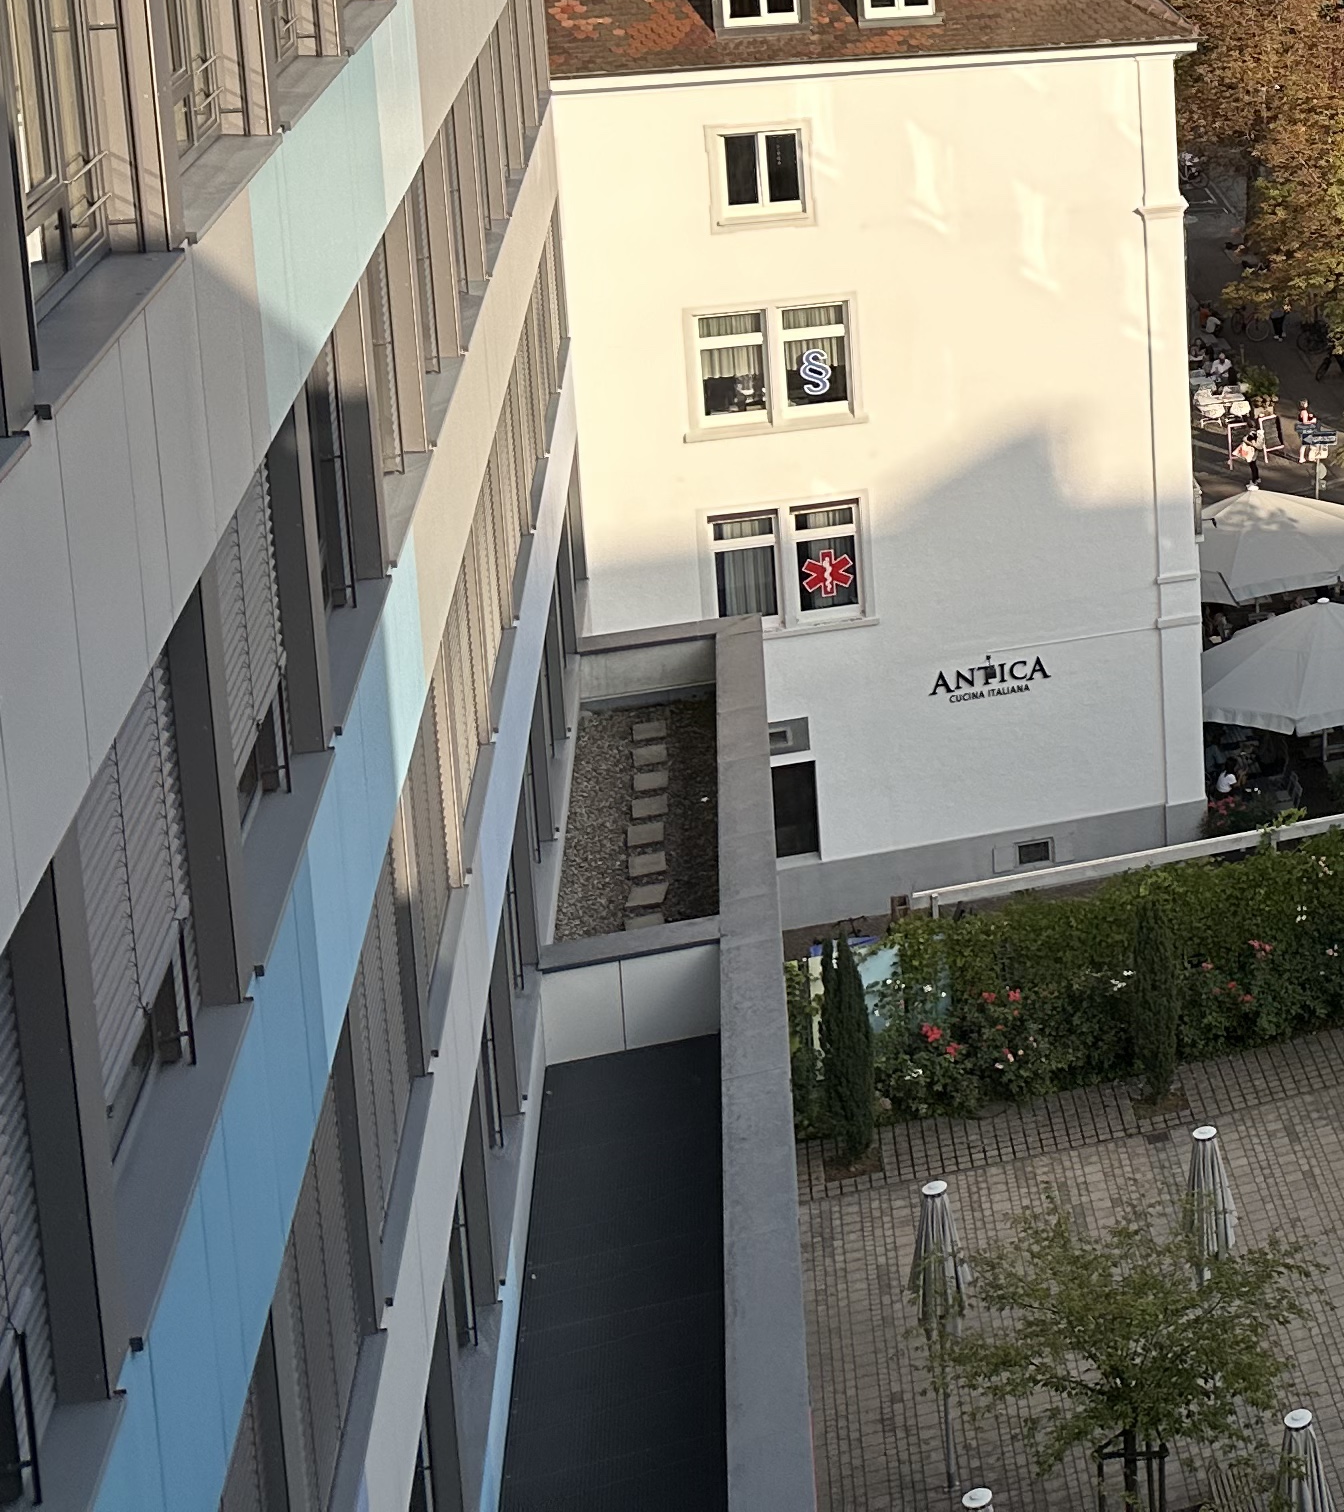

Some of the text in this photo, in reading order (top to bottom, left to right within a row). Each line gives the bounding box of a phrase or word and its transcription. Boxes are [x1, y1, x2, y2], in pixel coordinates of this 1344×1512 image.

[928, 656, 1051, 696] ANTICA
[949, 683, 1031, 704] CUCINA ITALIANA
